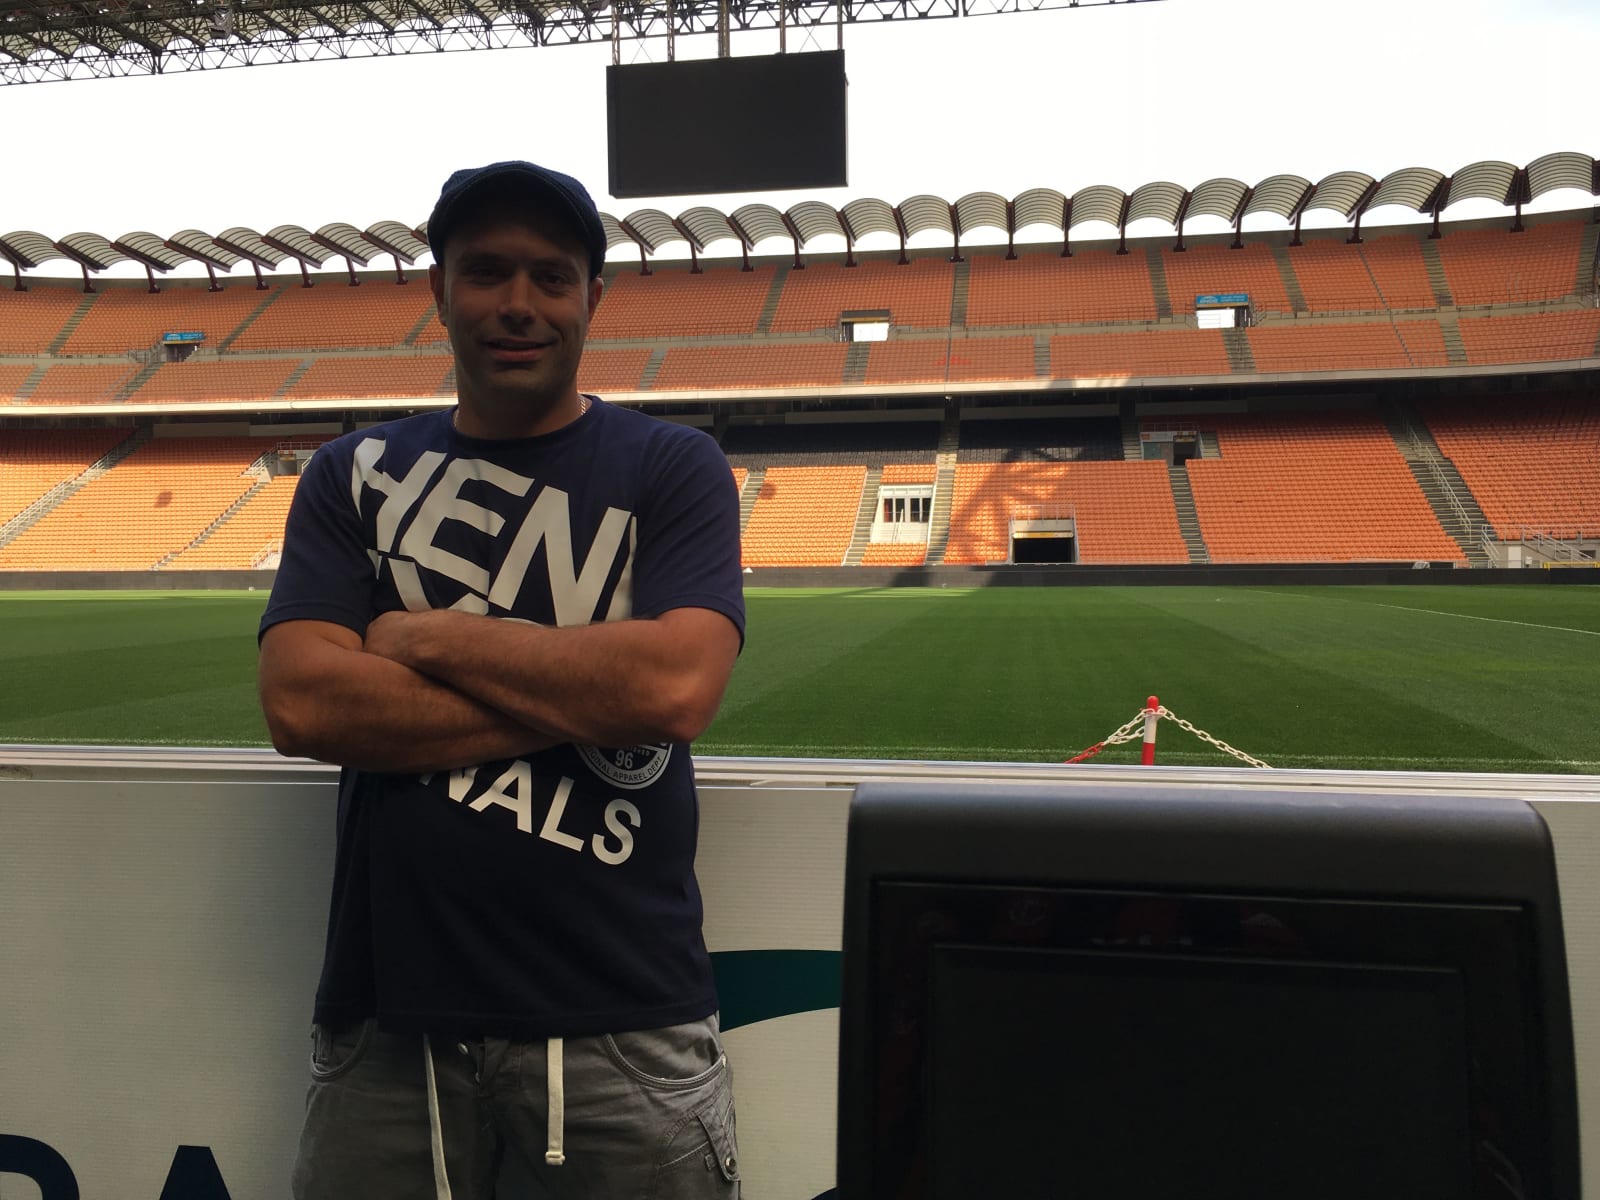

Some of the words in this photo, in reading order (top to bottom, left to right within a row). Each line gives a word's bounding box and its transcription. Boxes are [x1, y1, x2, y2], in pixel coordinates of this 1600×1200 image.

[613, 770, 648, 782] APPAREL
[647, 756, 663, 776] DEPT
[615, 750, 634, 770] 96
